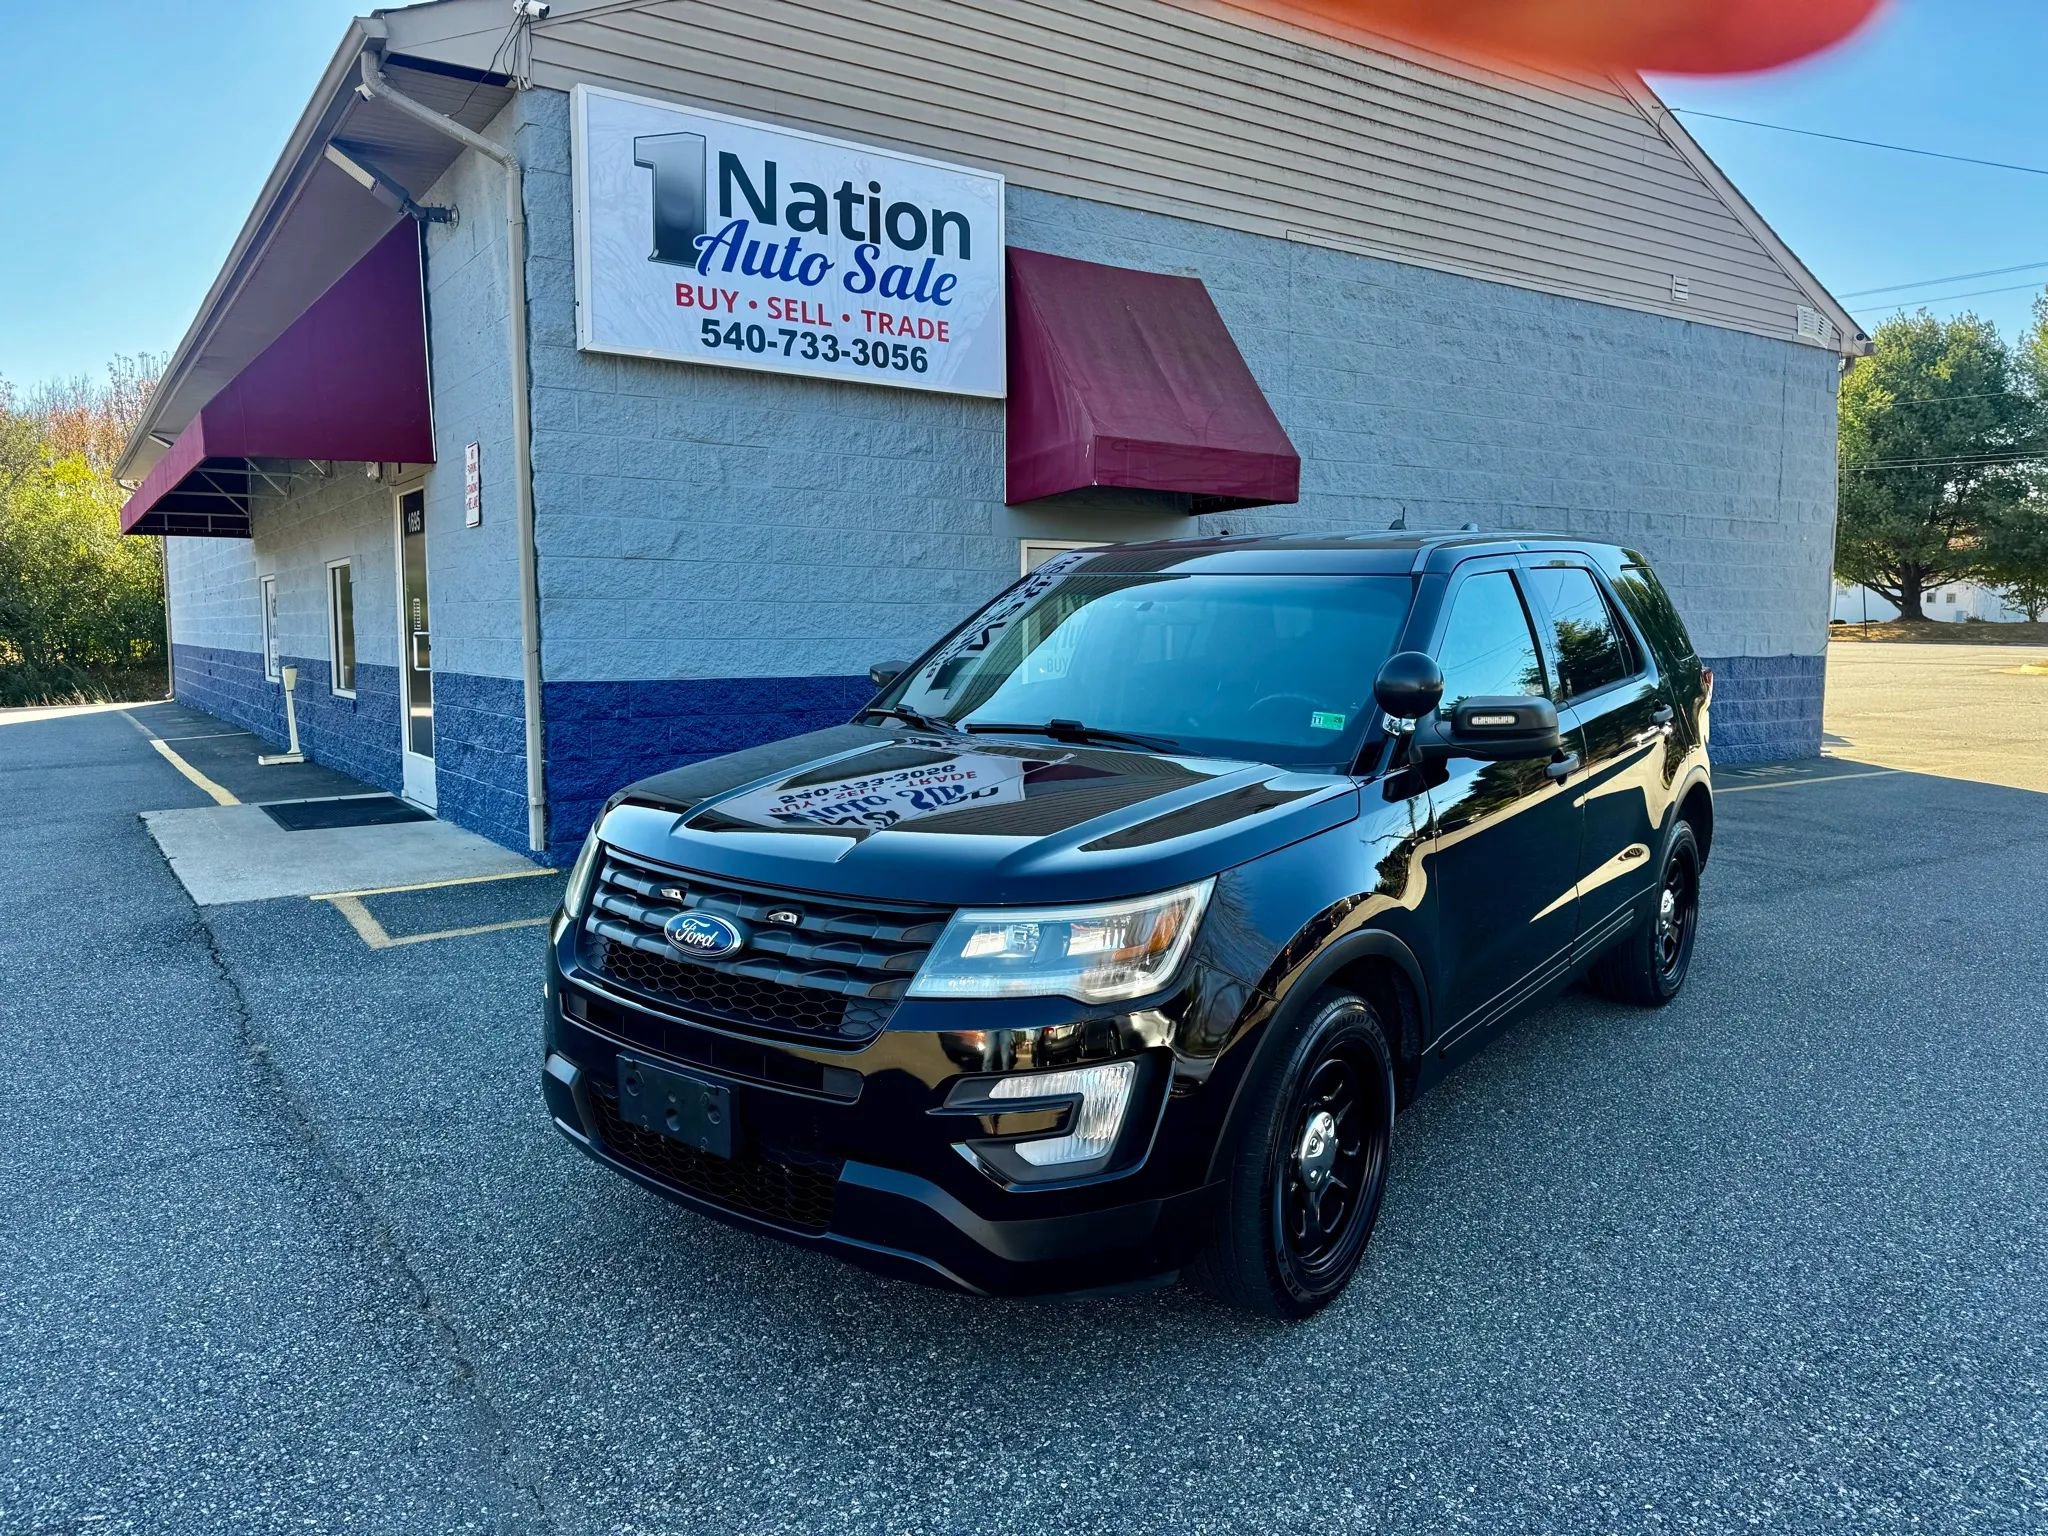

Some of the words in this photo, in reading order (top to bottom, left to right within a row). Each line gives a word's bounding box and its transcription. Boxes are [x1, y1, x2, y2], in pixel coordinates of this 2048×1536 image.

[634, 132, 706, 268] 1
[718, 150, 971, 260] Nation
[693, 218, 835, 287] Auto
[843, 243, 957, 306] Sale
[675, 282, 740, 314] BUY
[768, 296, 832, 327] SELL
[861, 309, 950, 342] TRADE
[701, 318, 928, 373] 540-733-3056
[676, 919, 718, 948] Ford
